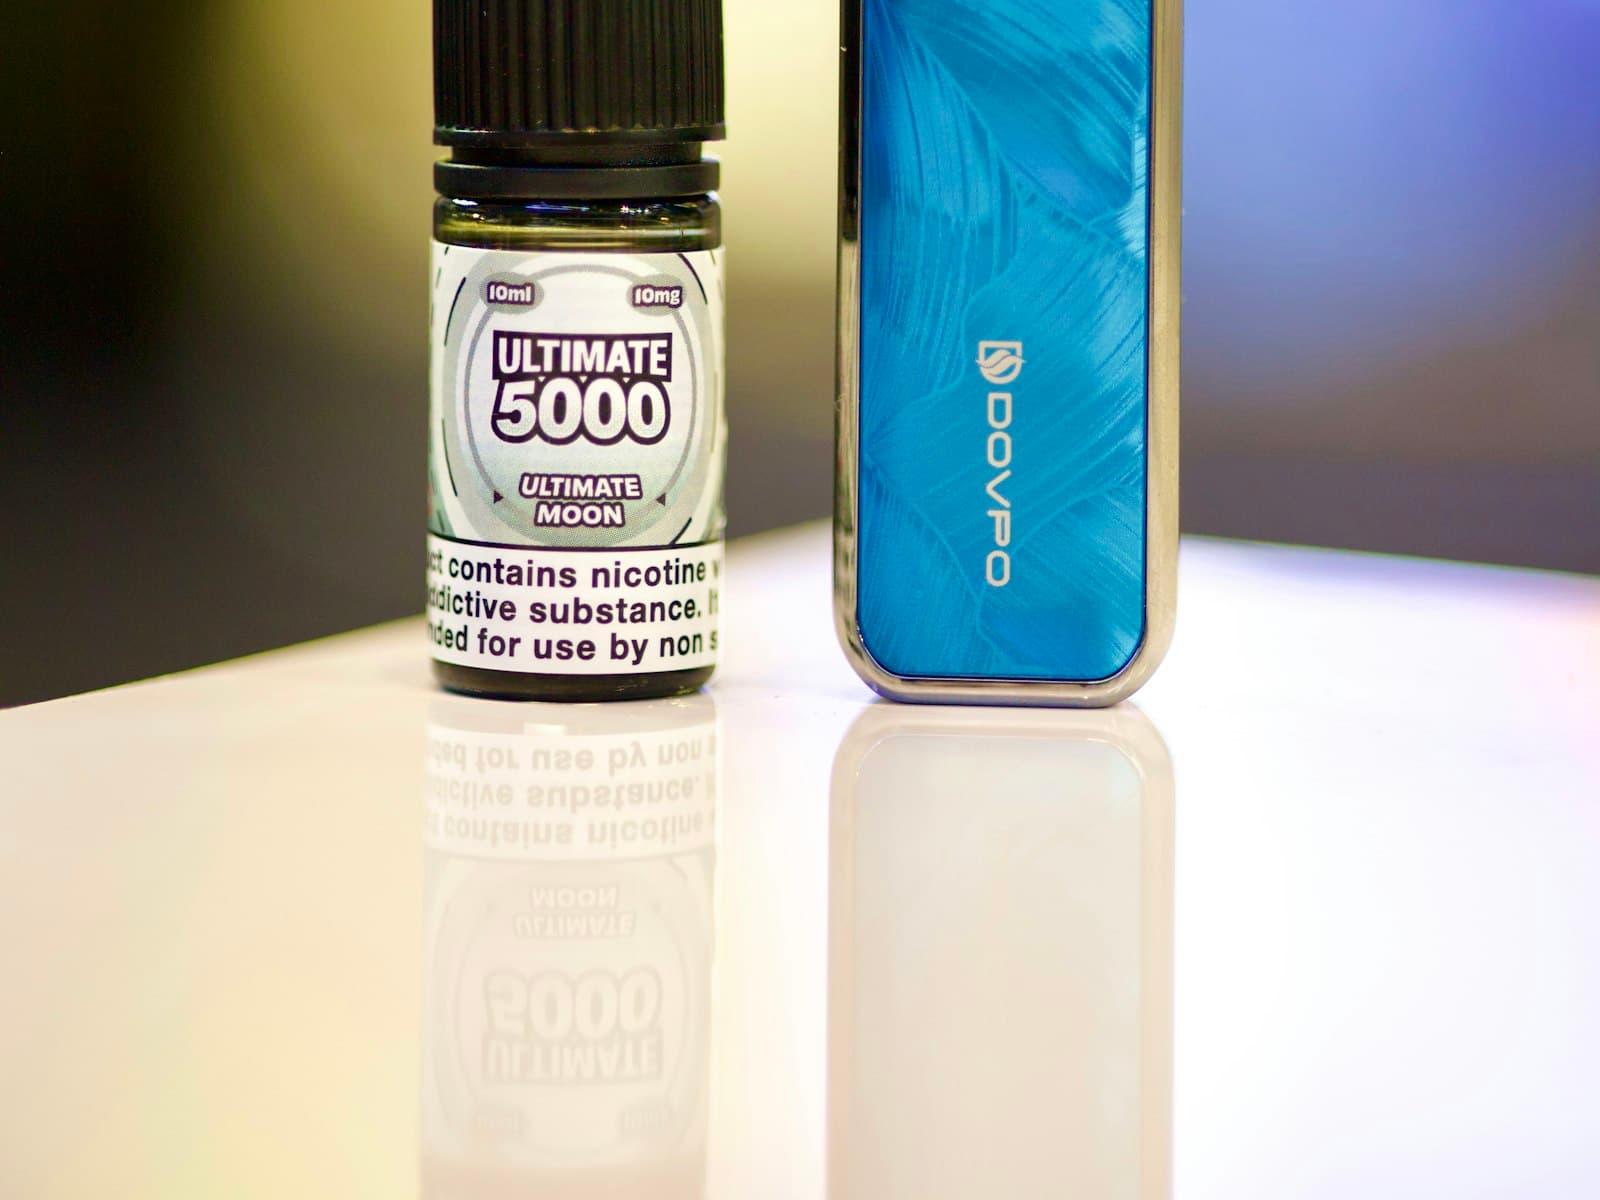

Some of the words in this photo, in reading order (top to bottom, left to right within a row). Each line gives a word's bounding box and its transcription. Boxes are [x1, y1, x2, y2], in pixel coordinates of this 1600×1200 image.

[488, 283, 533, 303] 10ml
[634, 286, 682, 307] 10mg
[497, 336, 669, 377] ULTIMATE
[494, 377, 669, 442] 5000
[520, 475, 641, 498] ULTIMATE
[986, 392, 1012, 587] DOVPO
[536, 503, 624, 526] MOON
[449, 557, 577, 588] contains
[591, 557, 706, 588] nicotine
[529, 597, 702, 625] substance.
[477, 627, 521, 658] for
[534, 637, 596, 661] use
[610, 632, 648, 666] by
[659, 631, 703, 658] non
